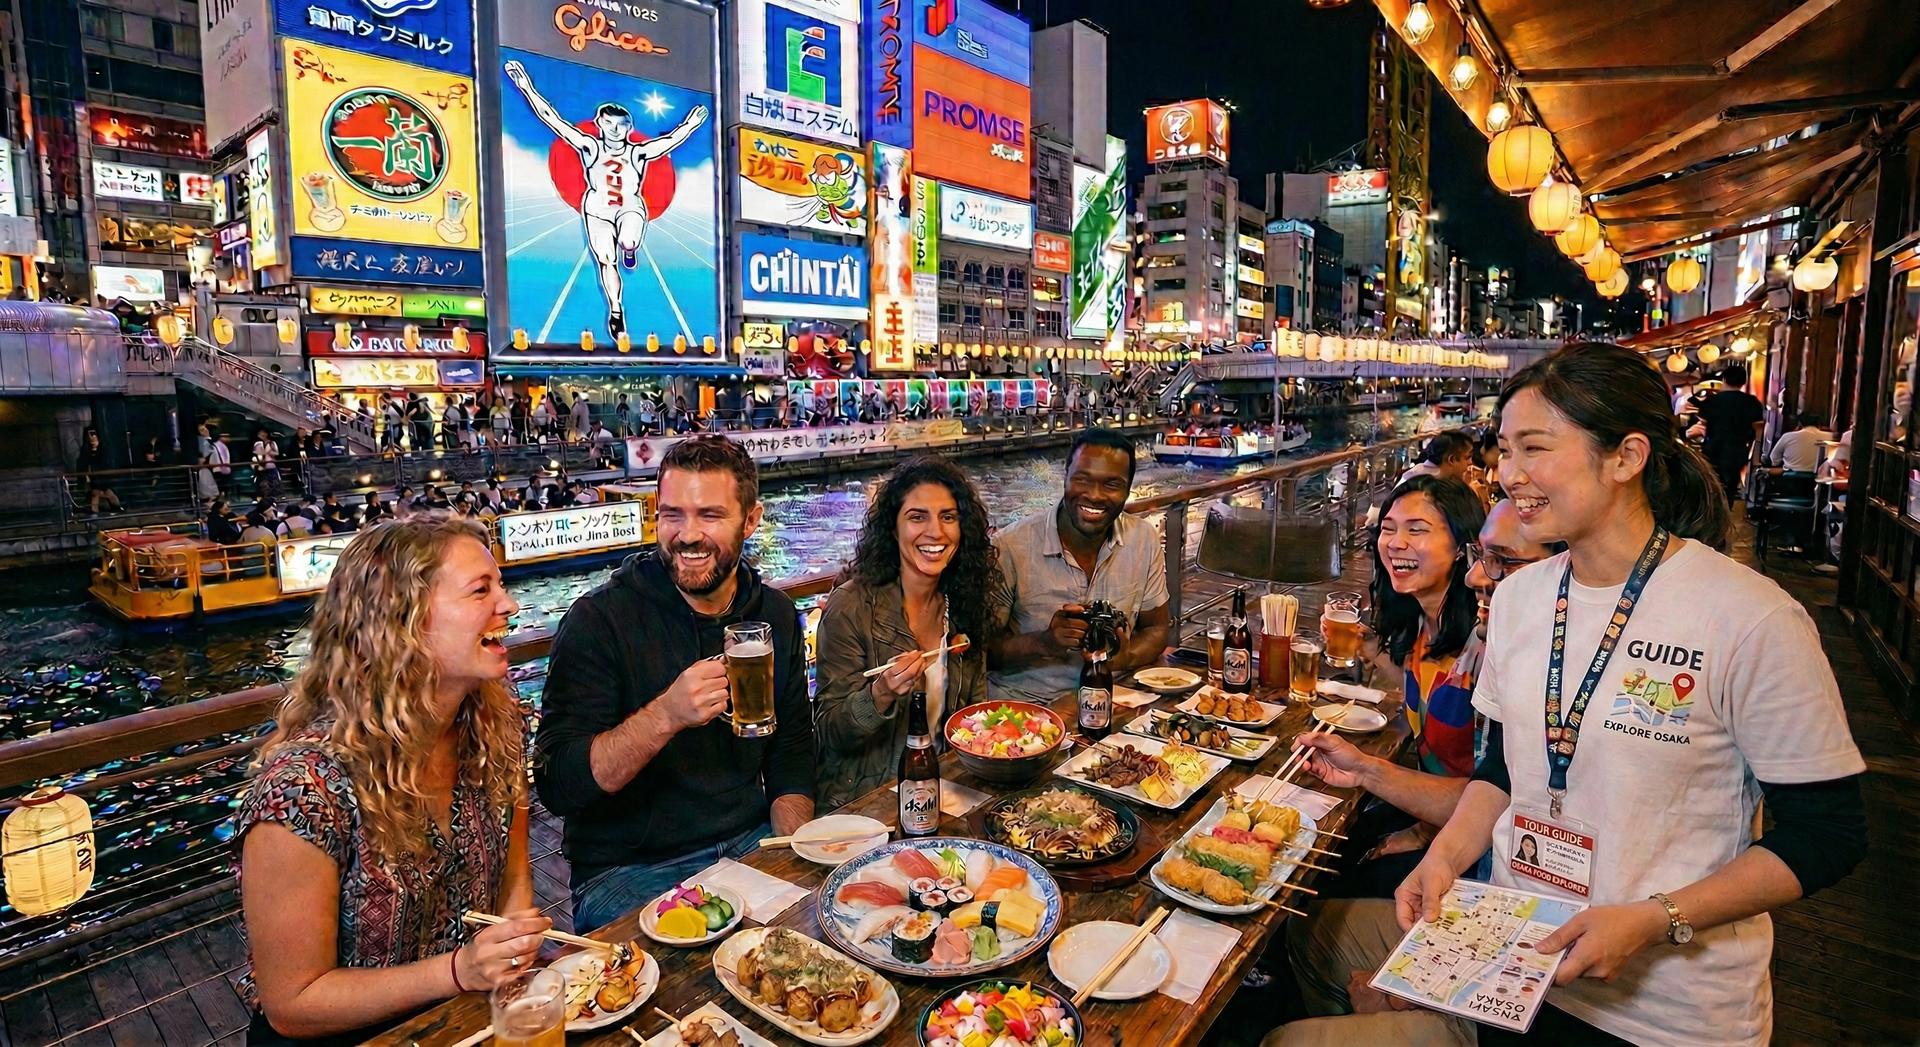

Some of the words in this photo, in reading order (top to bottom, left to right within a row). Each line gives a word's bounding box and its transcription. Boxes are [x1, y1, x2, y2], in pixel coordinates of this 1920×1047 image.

[924, 90, 1025, 147] PROMSE
[1627, 640, 1704, 671] GUIDE
[1603, 719, 1651, 739] EXPLORE
[1654, 730, 1691, 745] OSAKA
[1523, 819, 1550, 836] TOUR
[1551, 828, 1583, 846] GUIDE
[1476, 993, 1525, 1012] OSAKA
